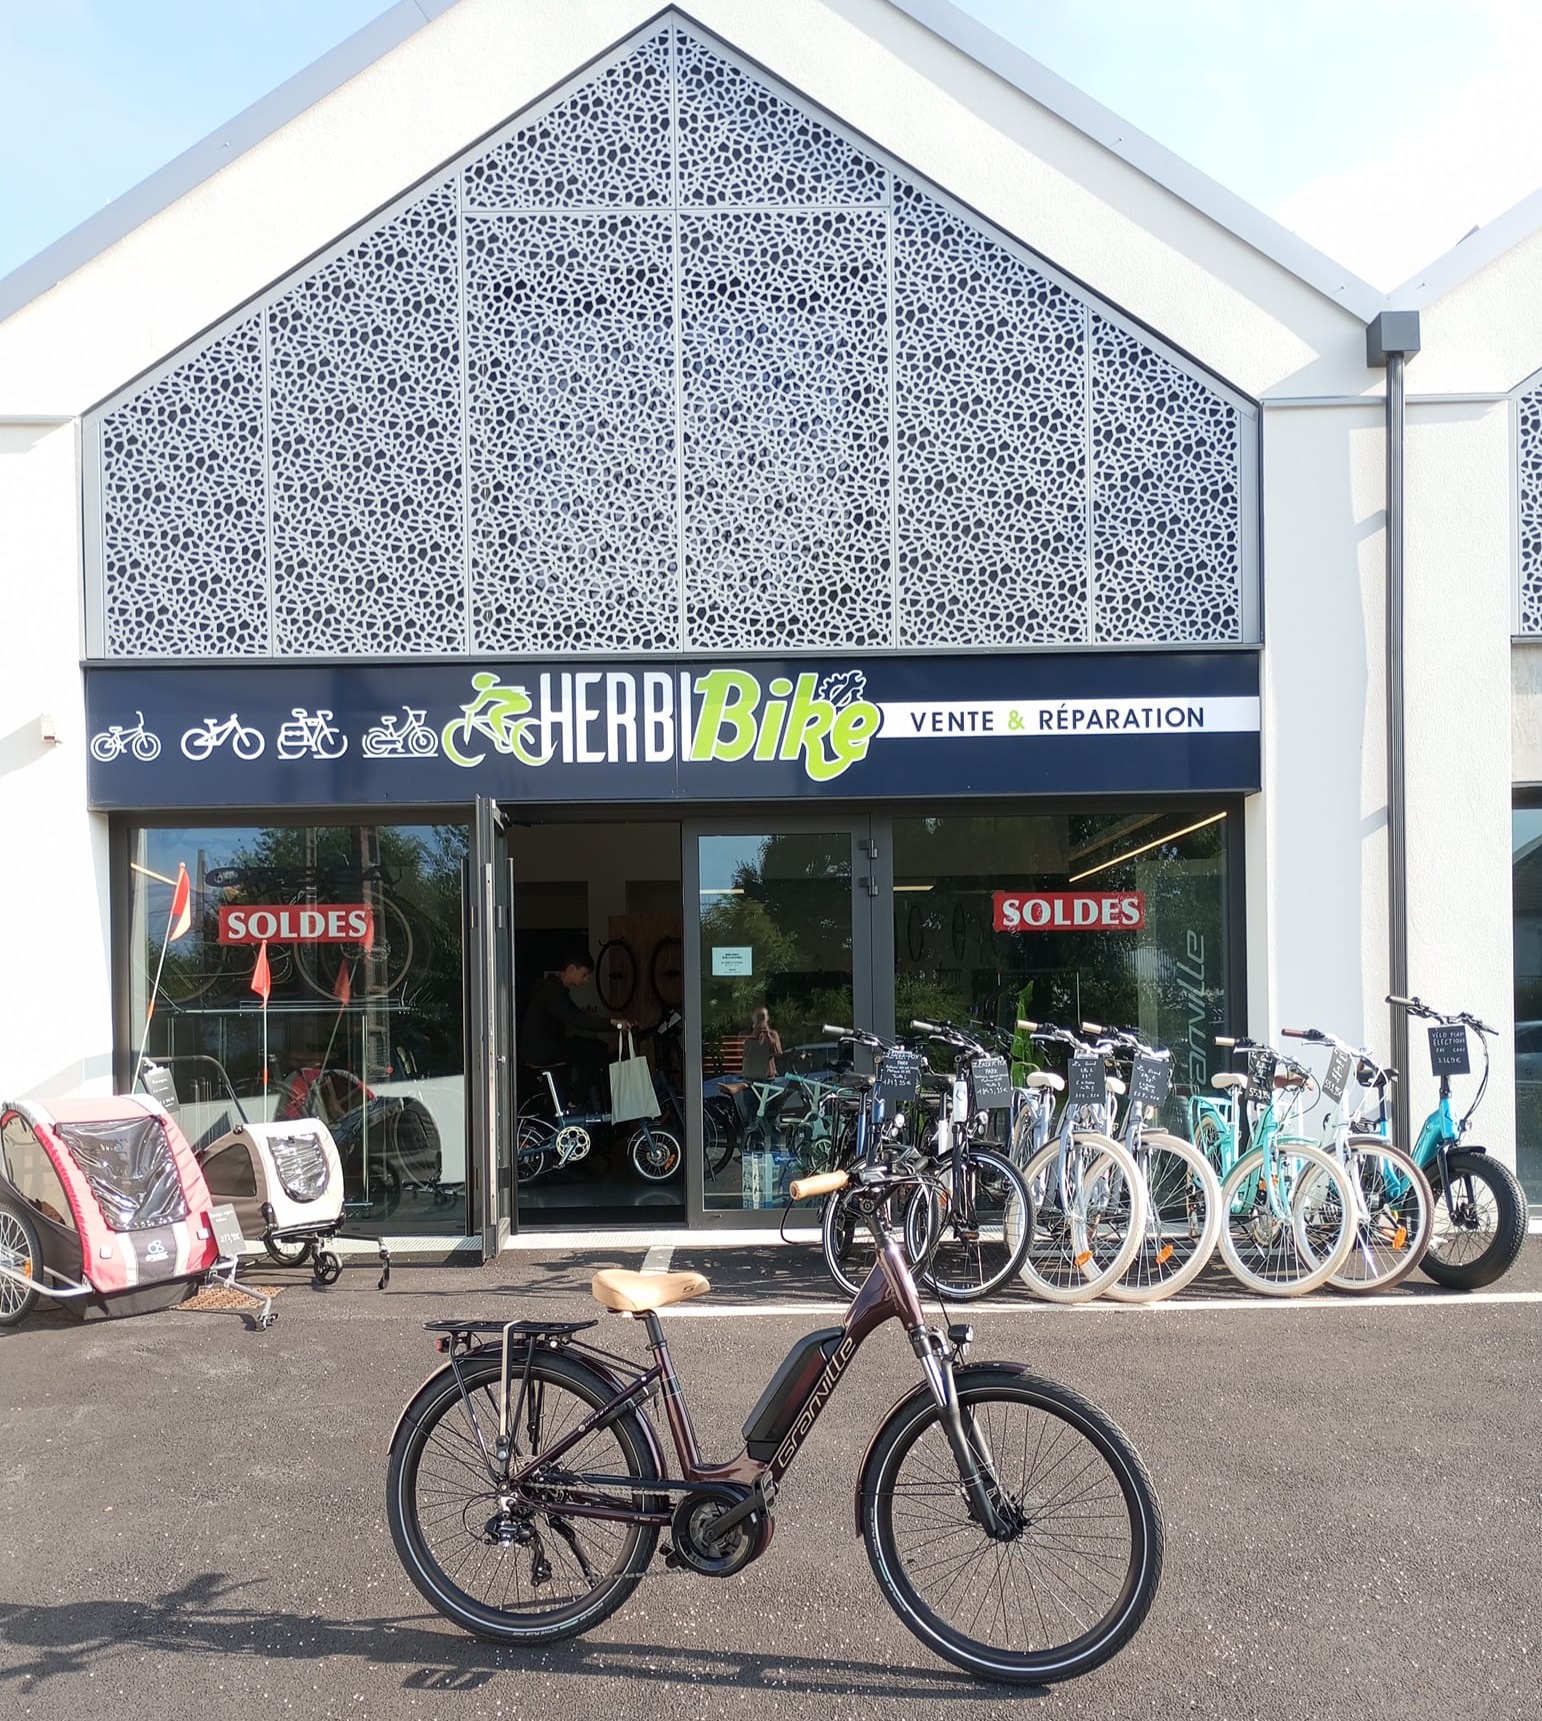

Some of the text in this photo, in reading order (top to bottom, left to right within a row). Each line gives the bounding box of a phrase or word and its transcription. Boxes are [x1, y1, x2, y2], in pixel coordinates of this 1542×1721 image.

[910, 703, 1205, 732] VENTE & RÉPARATION
[227, 911, 368, 939] SOLDES
[1002, 898, 1141, 926] SOLDES
[1177, 930, 1207, 1090] anville
[777, 1337, 857, 1469] Granville
